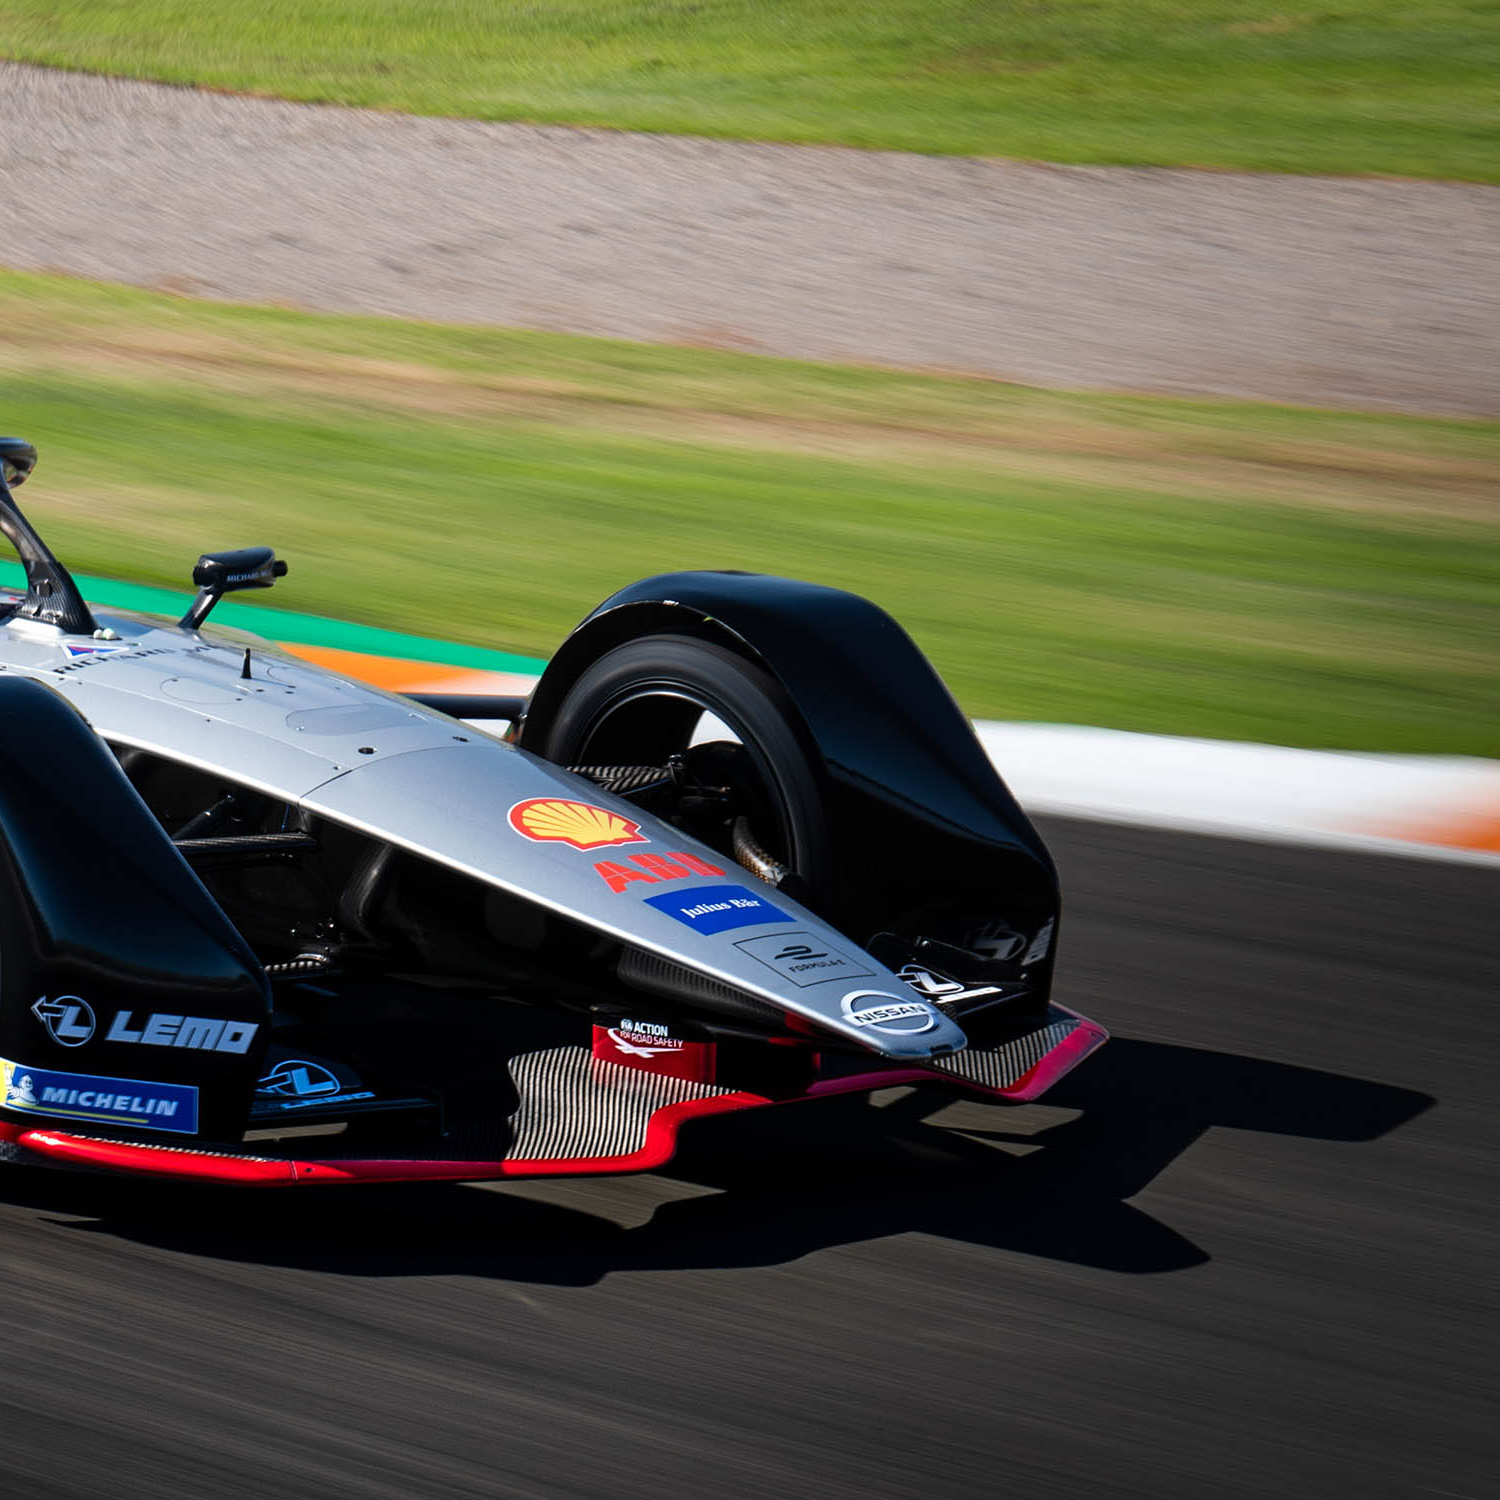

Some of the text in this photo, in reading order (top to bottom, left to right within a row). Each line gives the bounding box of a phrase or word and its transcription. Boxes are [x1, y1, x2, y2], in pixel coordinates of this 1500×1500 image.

[593, 852, 726, 894] ABB
[680, 898, 762, 919] Julius Bär
[853, 1005, 928, 1023] NISSAN
[105, 1010, 260, 1055] LEMO
[634, 1021, 669, 1037] ACTION
[631, 1032, 653, 1045] ROAD
[653, 1037, 684, 1049] SAFETY
[41, 1086, 179, 1117] MICHELIN
